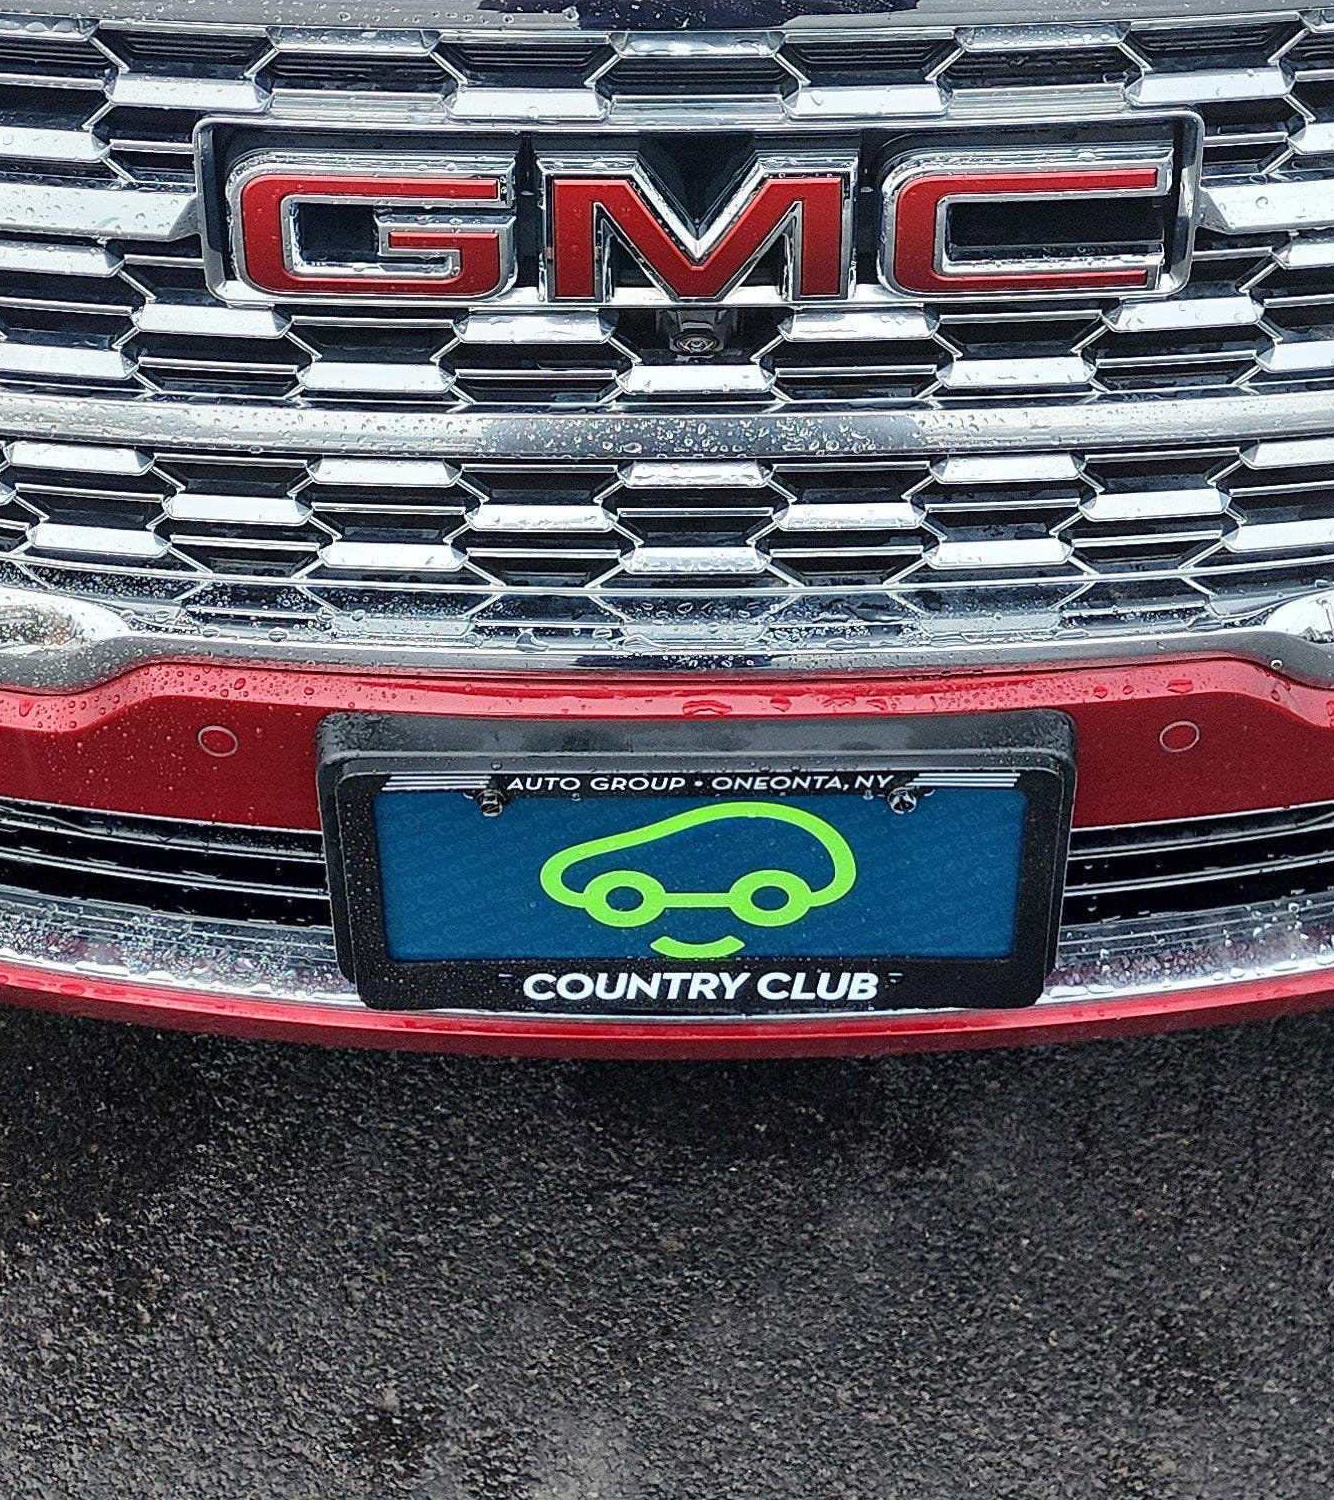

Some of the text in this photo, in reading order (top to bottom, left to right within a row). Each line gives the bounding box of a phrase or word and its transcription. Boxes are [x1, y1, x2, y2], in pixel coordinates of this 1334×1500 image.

[229, 145, 1174, 300] GMC
[506, 775, 895, 791] AUTO GROUP ONEONTA, NY
[522, 972, 880, 1001] COUNTRY CLUB
